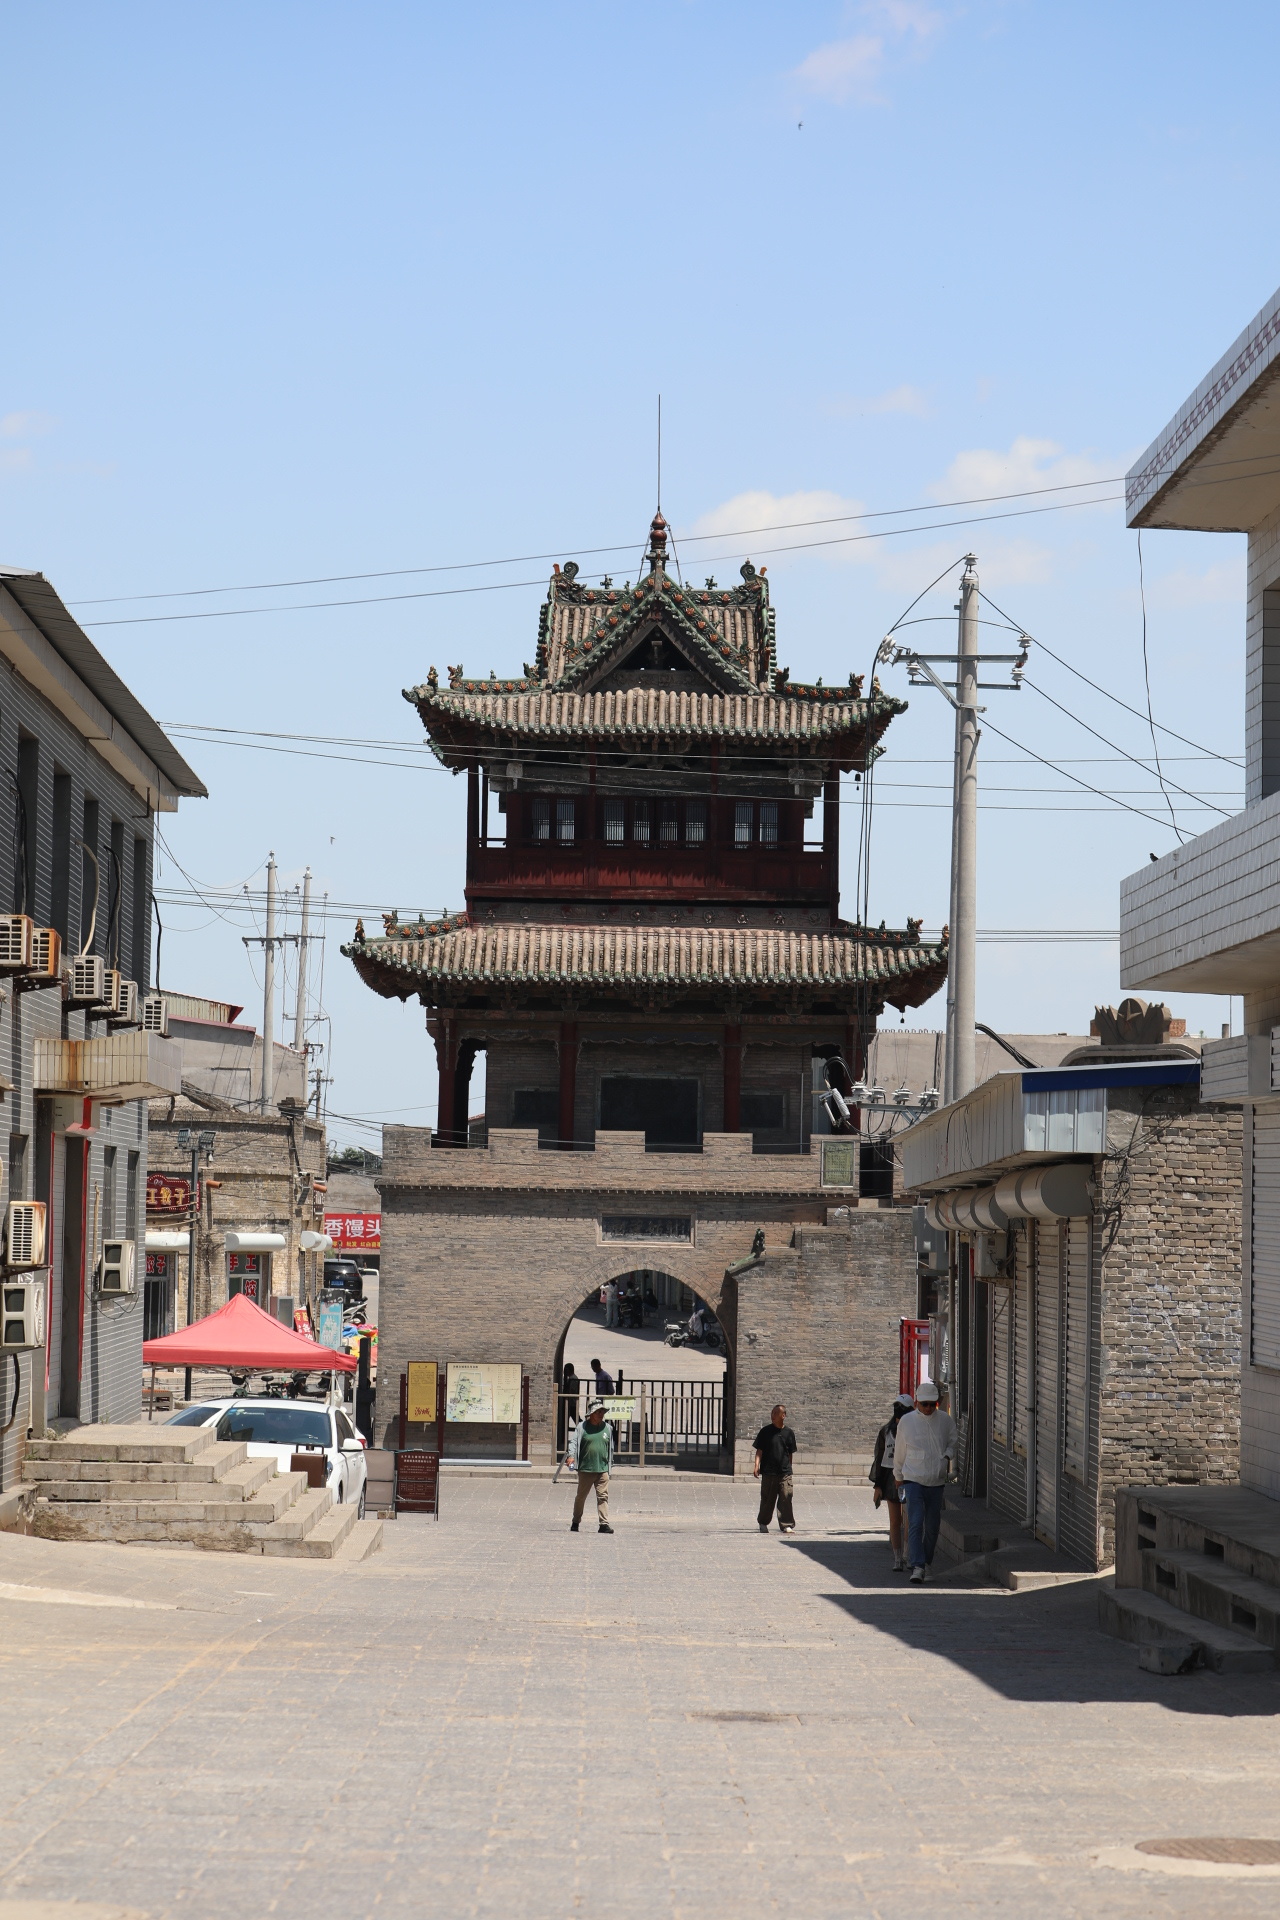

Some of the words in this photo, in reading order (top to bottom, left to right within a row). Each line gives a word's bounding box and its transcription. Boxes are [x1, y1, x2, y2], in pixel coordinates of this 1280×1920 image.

[324, 1218, 381, 1238] 香馒头
[229, 1253, 257, 1272] 手工
[245, 1280, 257, 1297] 饺
